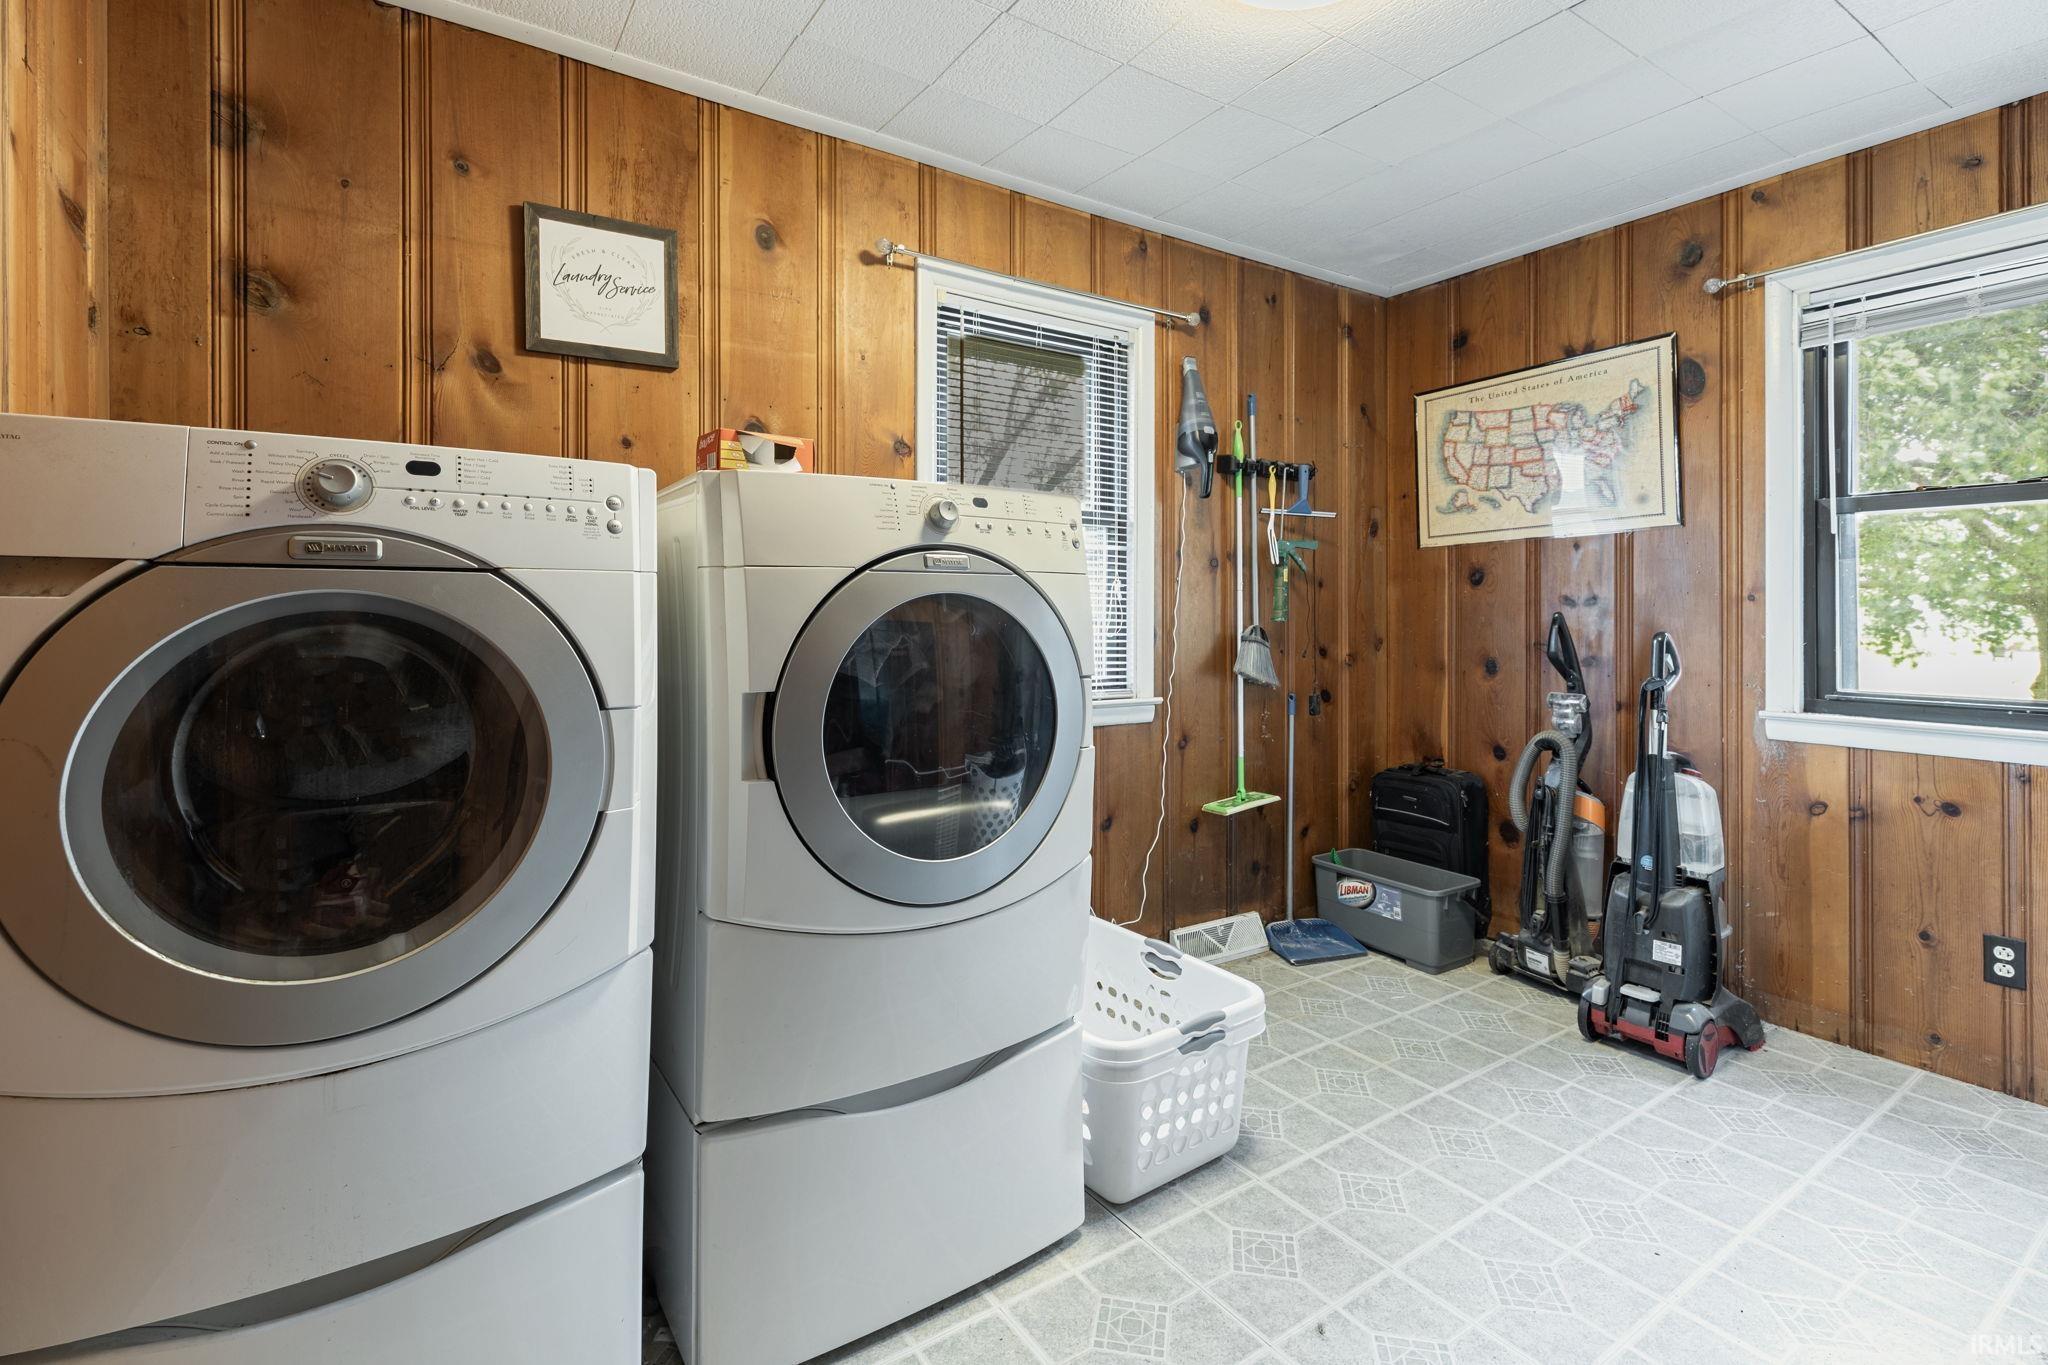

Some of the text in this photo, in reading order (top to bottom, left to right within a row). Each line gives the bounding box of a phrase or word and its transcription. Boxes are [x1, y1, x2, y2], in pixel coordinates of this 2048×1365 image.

[552, 262, 656, 300] Laundry Service
[1468, 369, 1608, 404] The United States of America
[323, 543, 369, 553] MAYTAG
[1340, 884, 1369, 896] LIBMAN
